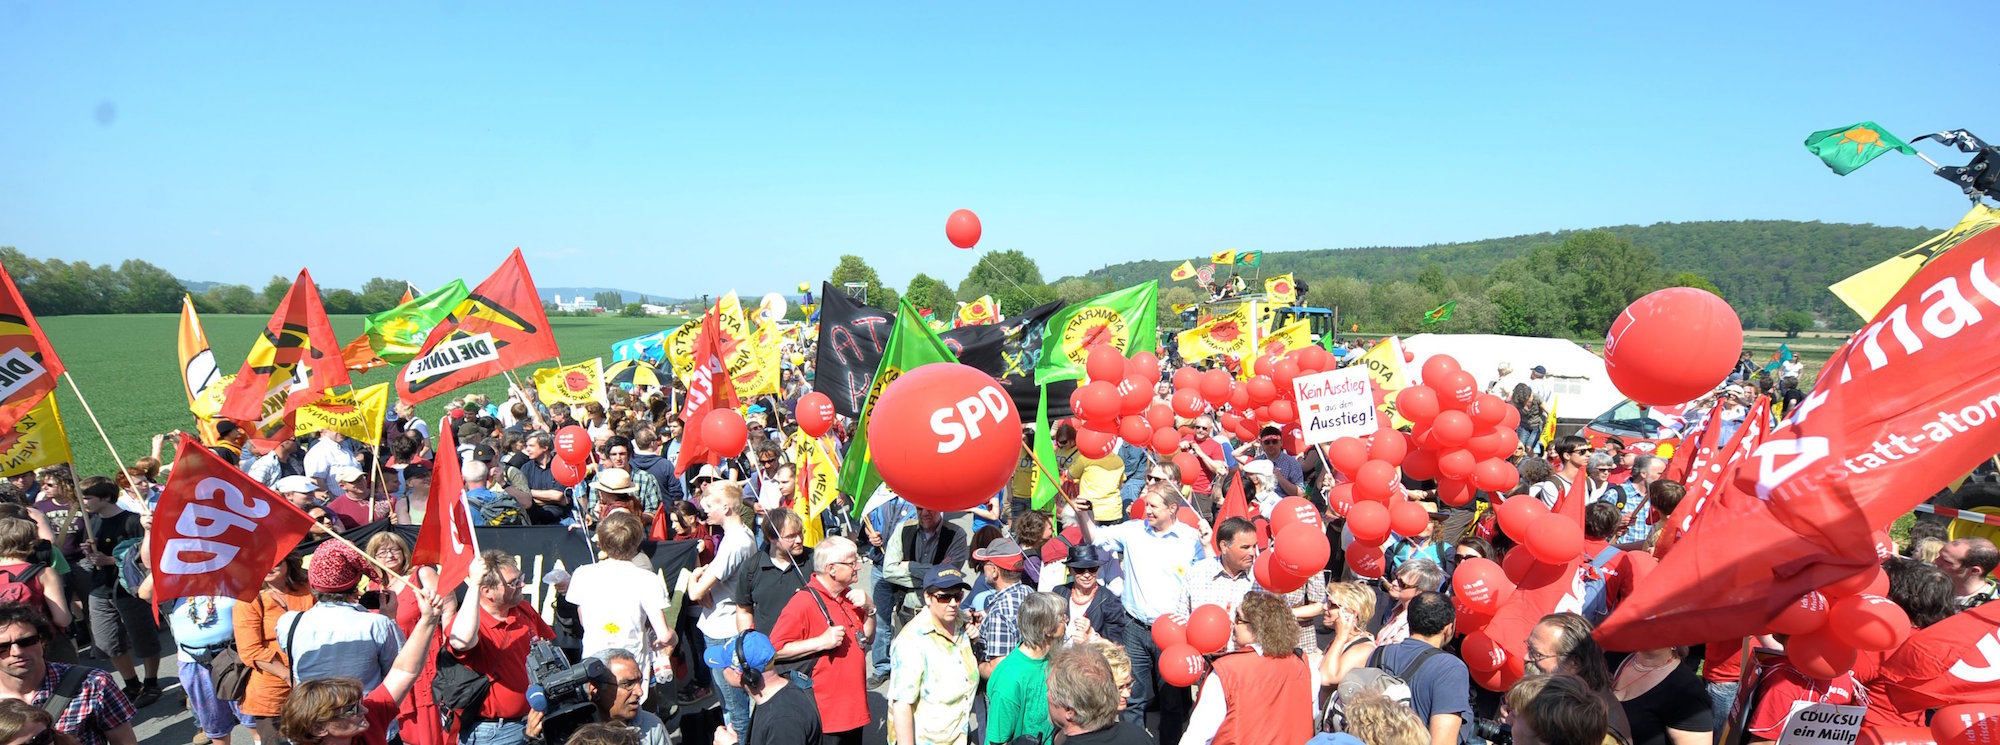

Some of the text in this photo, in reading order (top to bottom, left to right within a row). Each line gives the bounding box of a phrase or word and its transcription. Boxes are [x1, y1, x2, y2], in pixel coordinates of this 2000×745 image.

[1299, 377, 1365, 400] Kein Ausstieg
[1325, 400, 1354, 411] aus dem
[929, 385, 1009, 454] SPD
[1310, 410, 1366, 431] Ausstieg
[1800, 597, 1808, 609] Ich
[1800, 711, 1859, 726] CDU/CSU
[1793, 726, 1815, 738] ein
